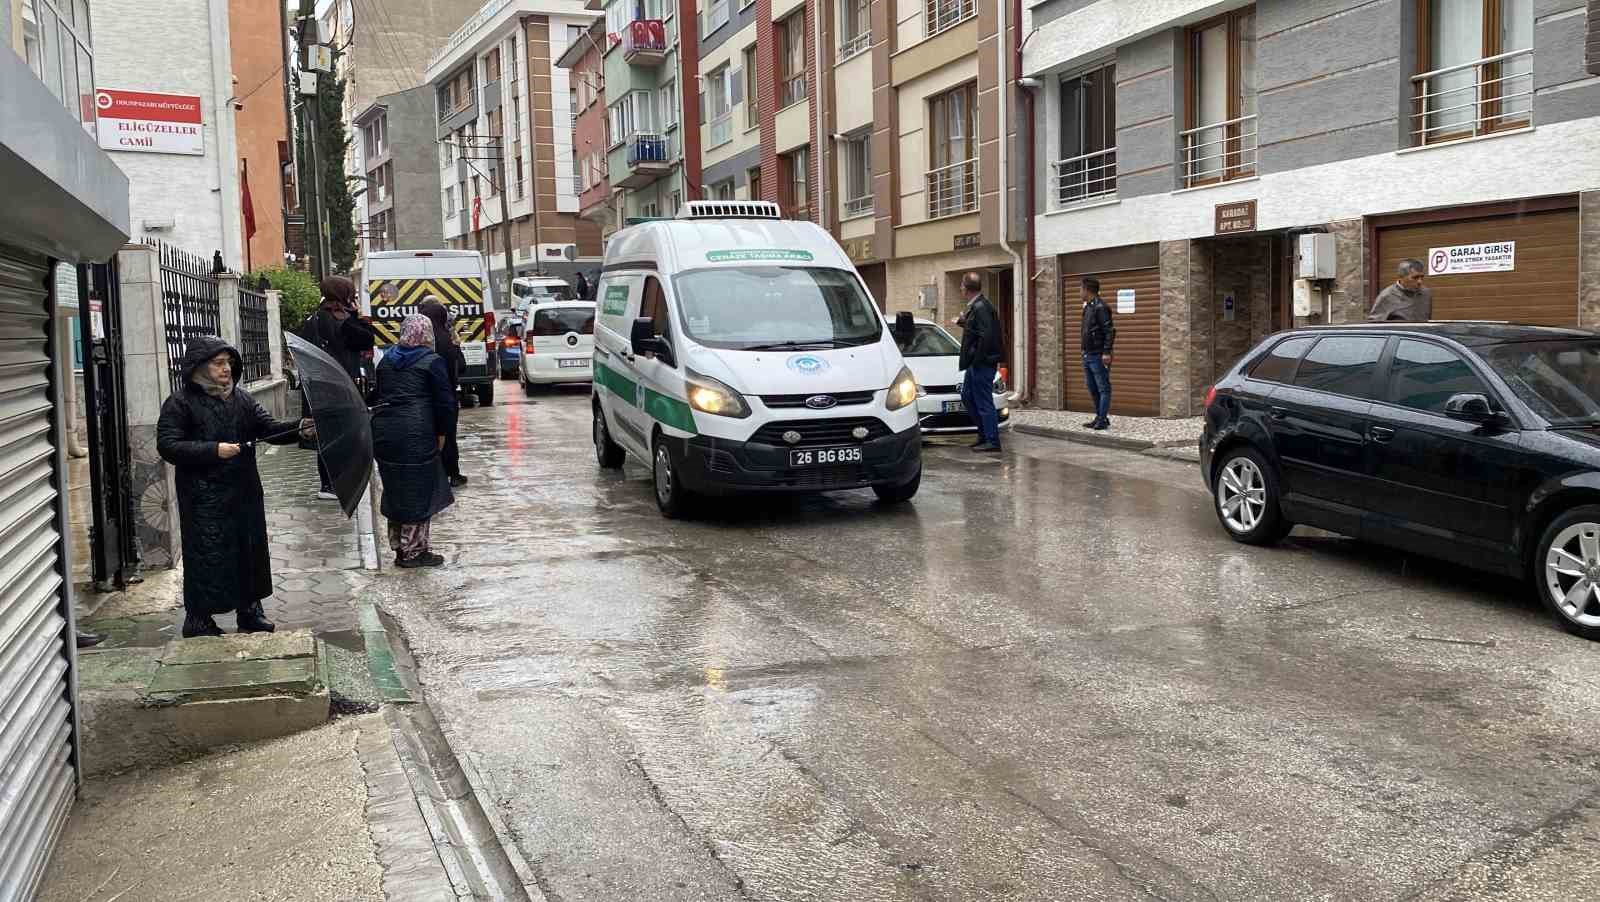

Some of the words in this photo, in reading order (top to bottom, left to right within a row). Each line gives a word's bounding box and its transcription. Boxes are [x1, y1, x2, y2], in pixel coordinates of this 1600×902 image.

[119, 121, 197, 135] ELİGÜZELLER
[119, 136, 153, 147] CAMİİ
[1450, 247, 1481, 257] GARAJ
[797, 452, 812, 465] 26
[818, 450, 836, 463] BG
[838, 448, 861, 462] 835
